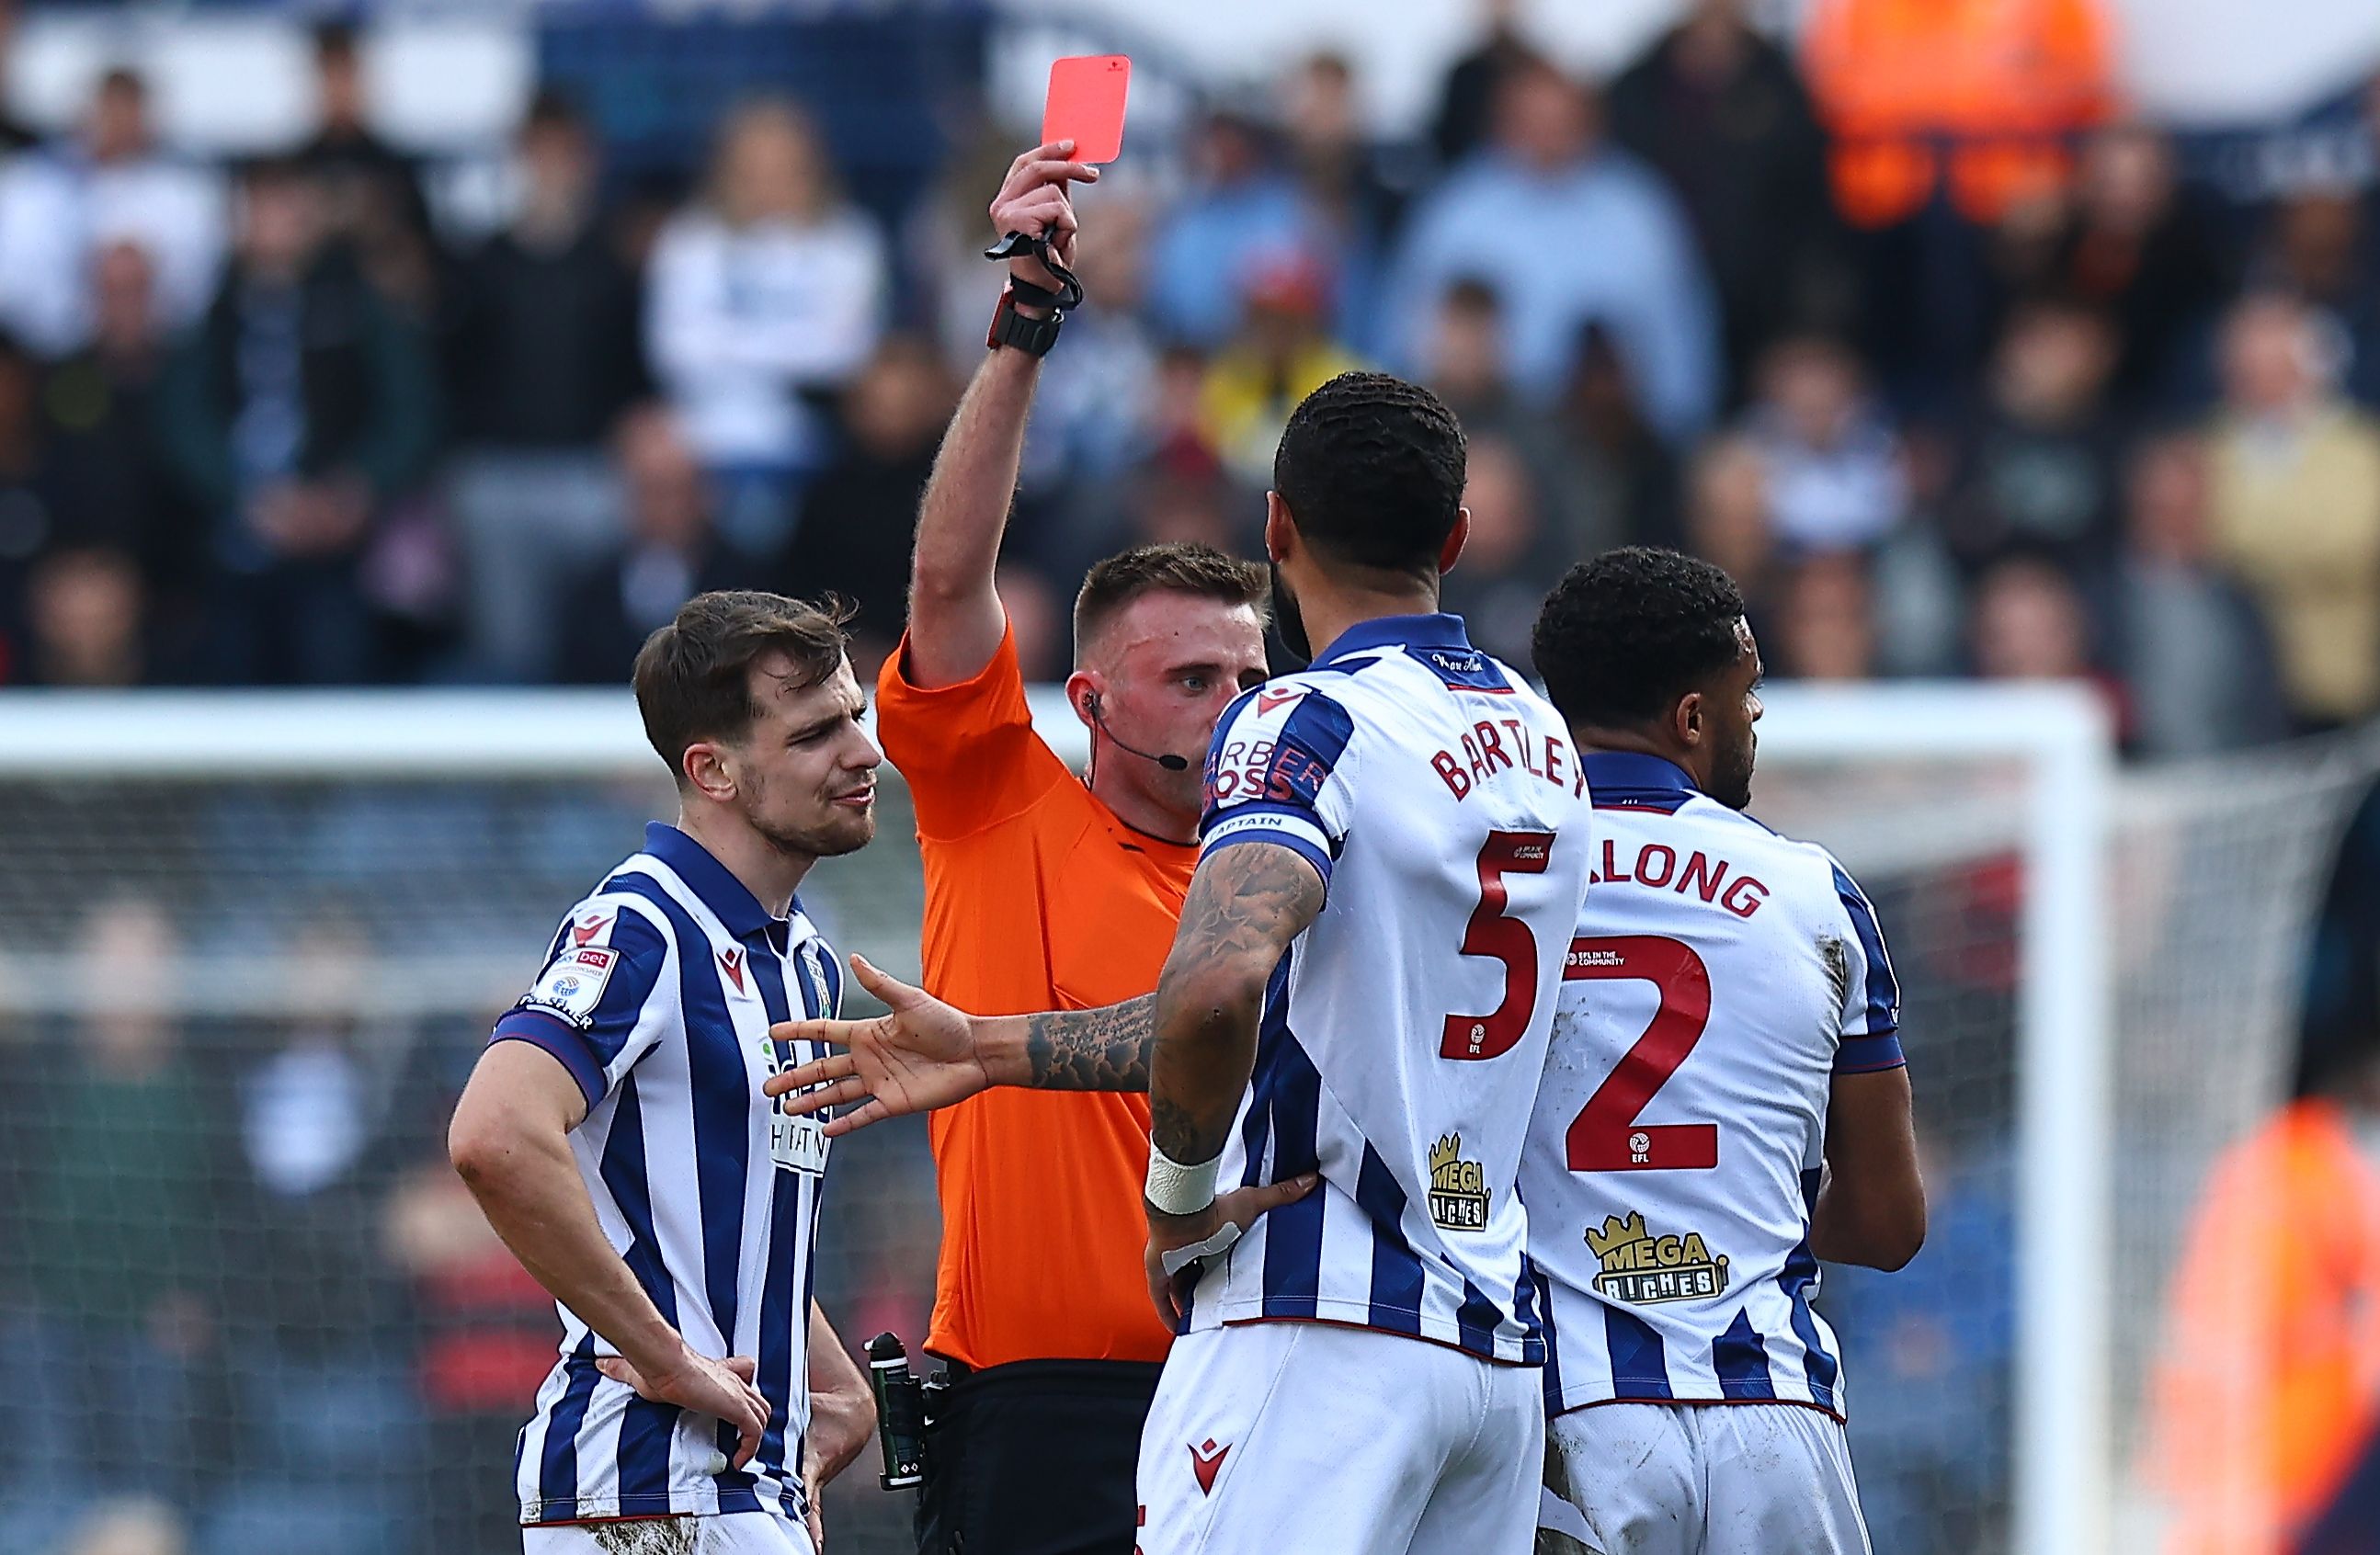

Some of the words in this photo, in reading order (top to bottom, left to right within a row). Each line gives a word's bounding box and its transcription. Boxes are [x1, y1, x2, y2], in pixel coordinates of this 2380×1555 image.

[1430, 720, 1585, 802] BARTLEY
[1589, 839, 1771, 918] LONG
[579, 951, 606, 966] bet
[1440, 829, 1557, 1061] 5
[1578, 958, 1625, 966] COMMUNITY
[1468, 1043, 1481, 1054] EFL
[1564, 935, 1718, 1172] 2
[1631, 1153, 1649, 1163] EFL
[1433, 1162, 1482, 1193] MEGA
[1602, 1233, 1710, 1272] MEGA
